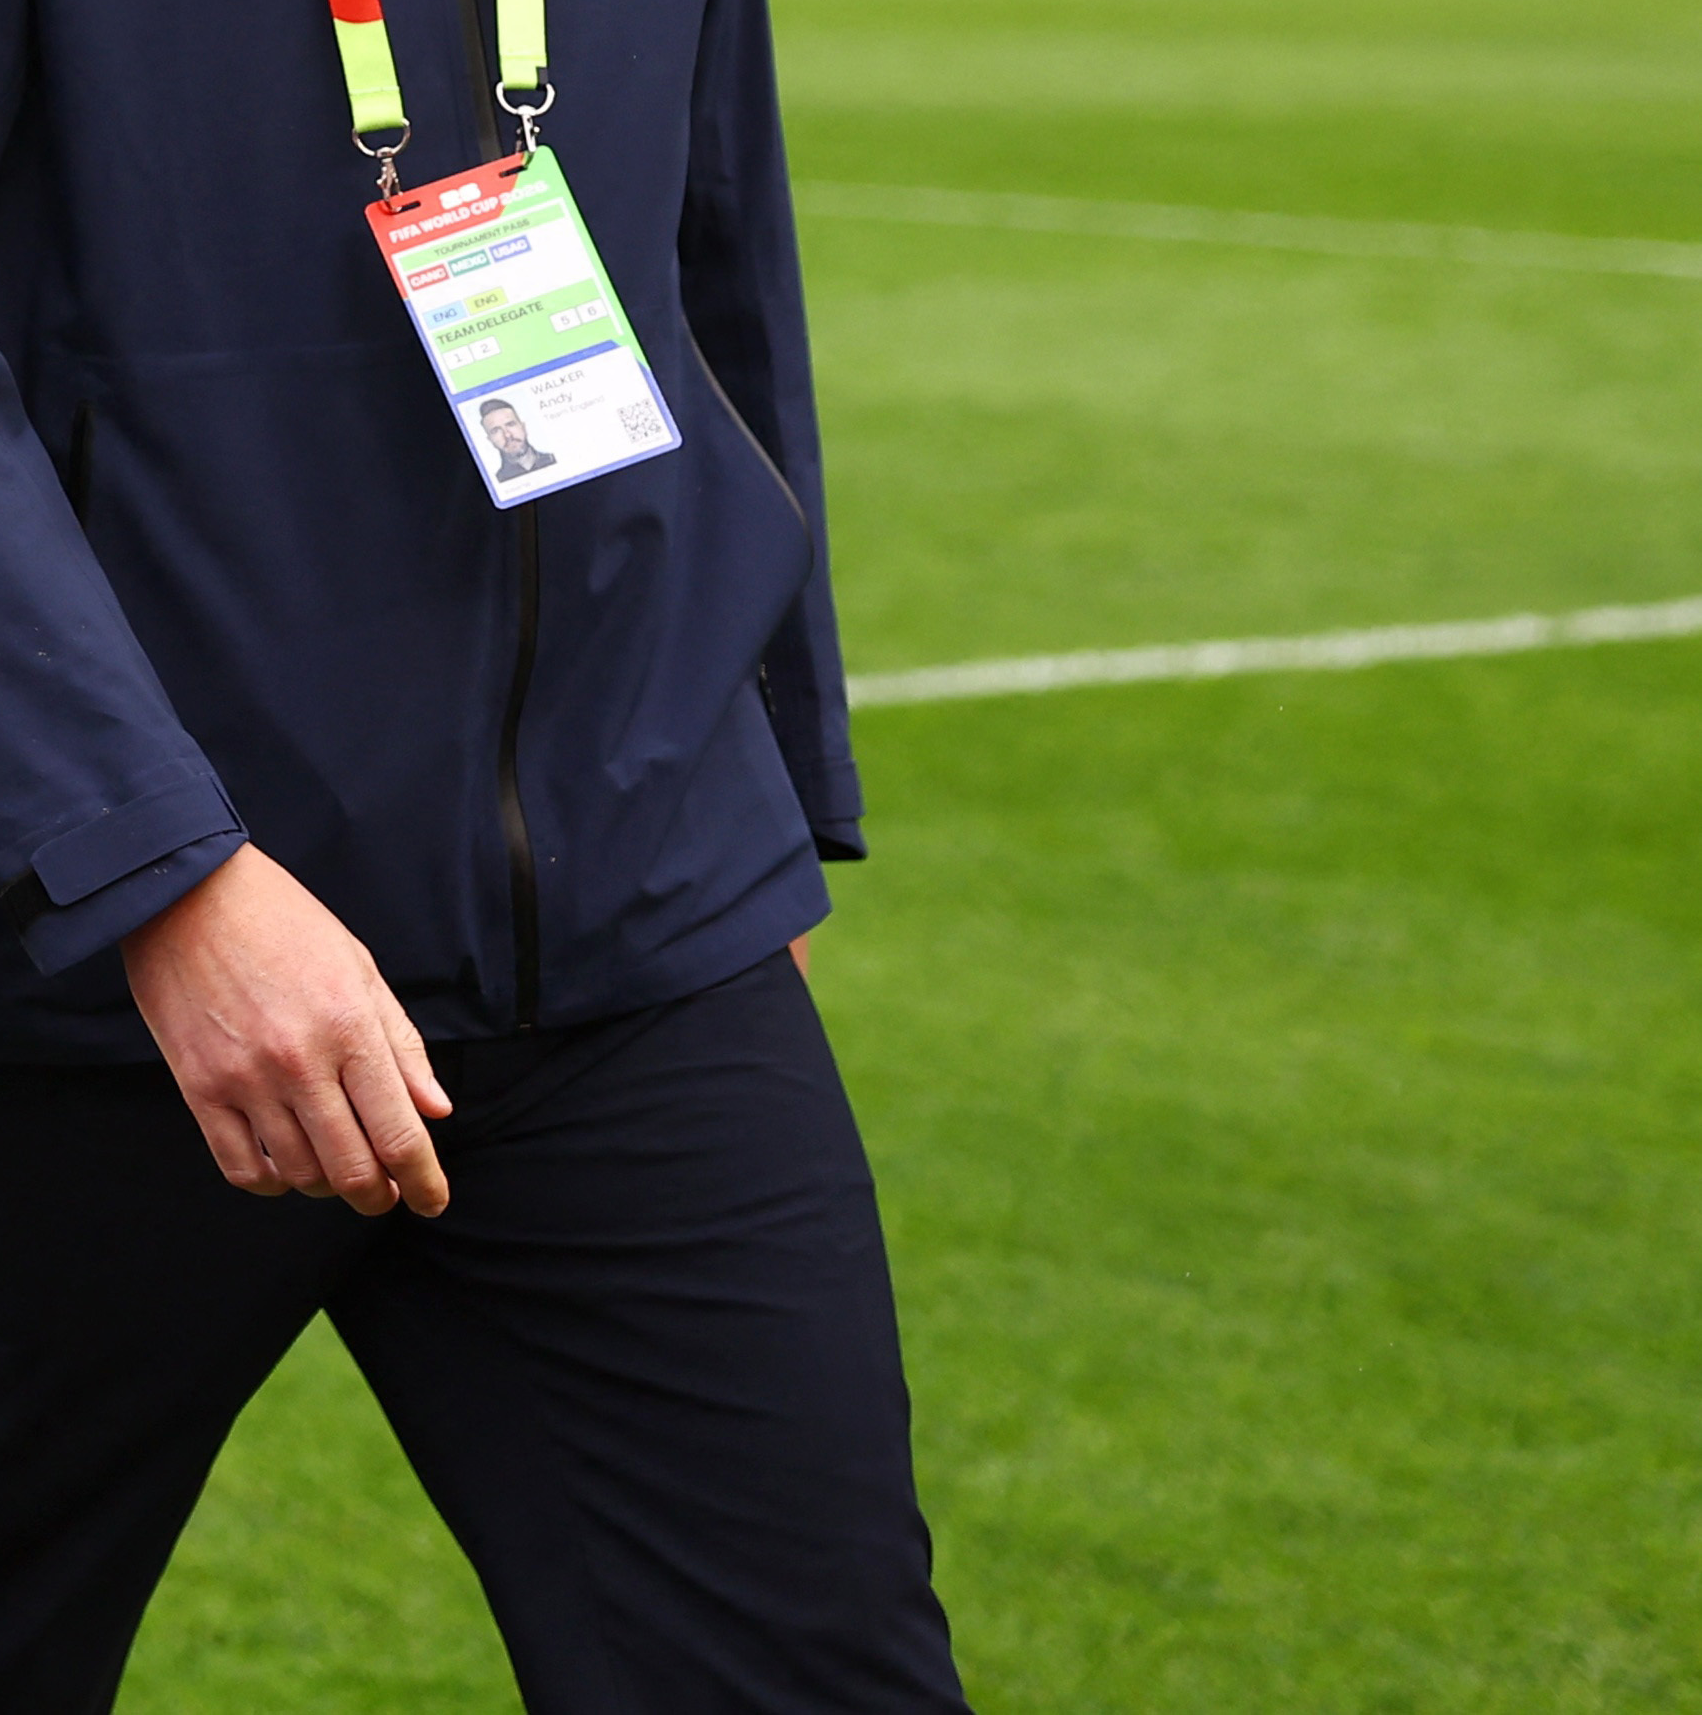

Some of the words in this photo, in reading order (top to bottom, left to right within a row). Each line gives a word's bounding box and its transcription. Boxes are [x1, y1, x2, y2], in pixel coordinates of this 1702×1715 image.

[388, 225, 422, 244] FIFA
[418, 206, 471, 234] WORLD
[469, 196, 500, 216] CUP
[433, 229, 504, 257] TOURNAMENT
[502, 218, 531, 234] PASS
[432, 308, 458, 324] ENG
[474, 294, 499, 310] ENG
[561, 316, 571, 326] 5
[587, 306, 598, 316] 6
[437, 325, 476, 346] TEAM
[476, 301, 545, 333] DELEGATE
[480, 343, 491, 354] 2
[530, 369, 586, 396] WALKER
[539, 392, 574, 411] Andy
